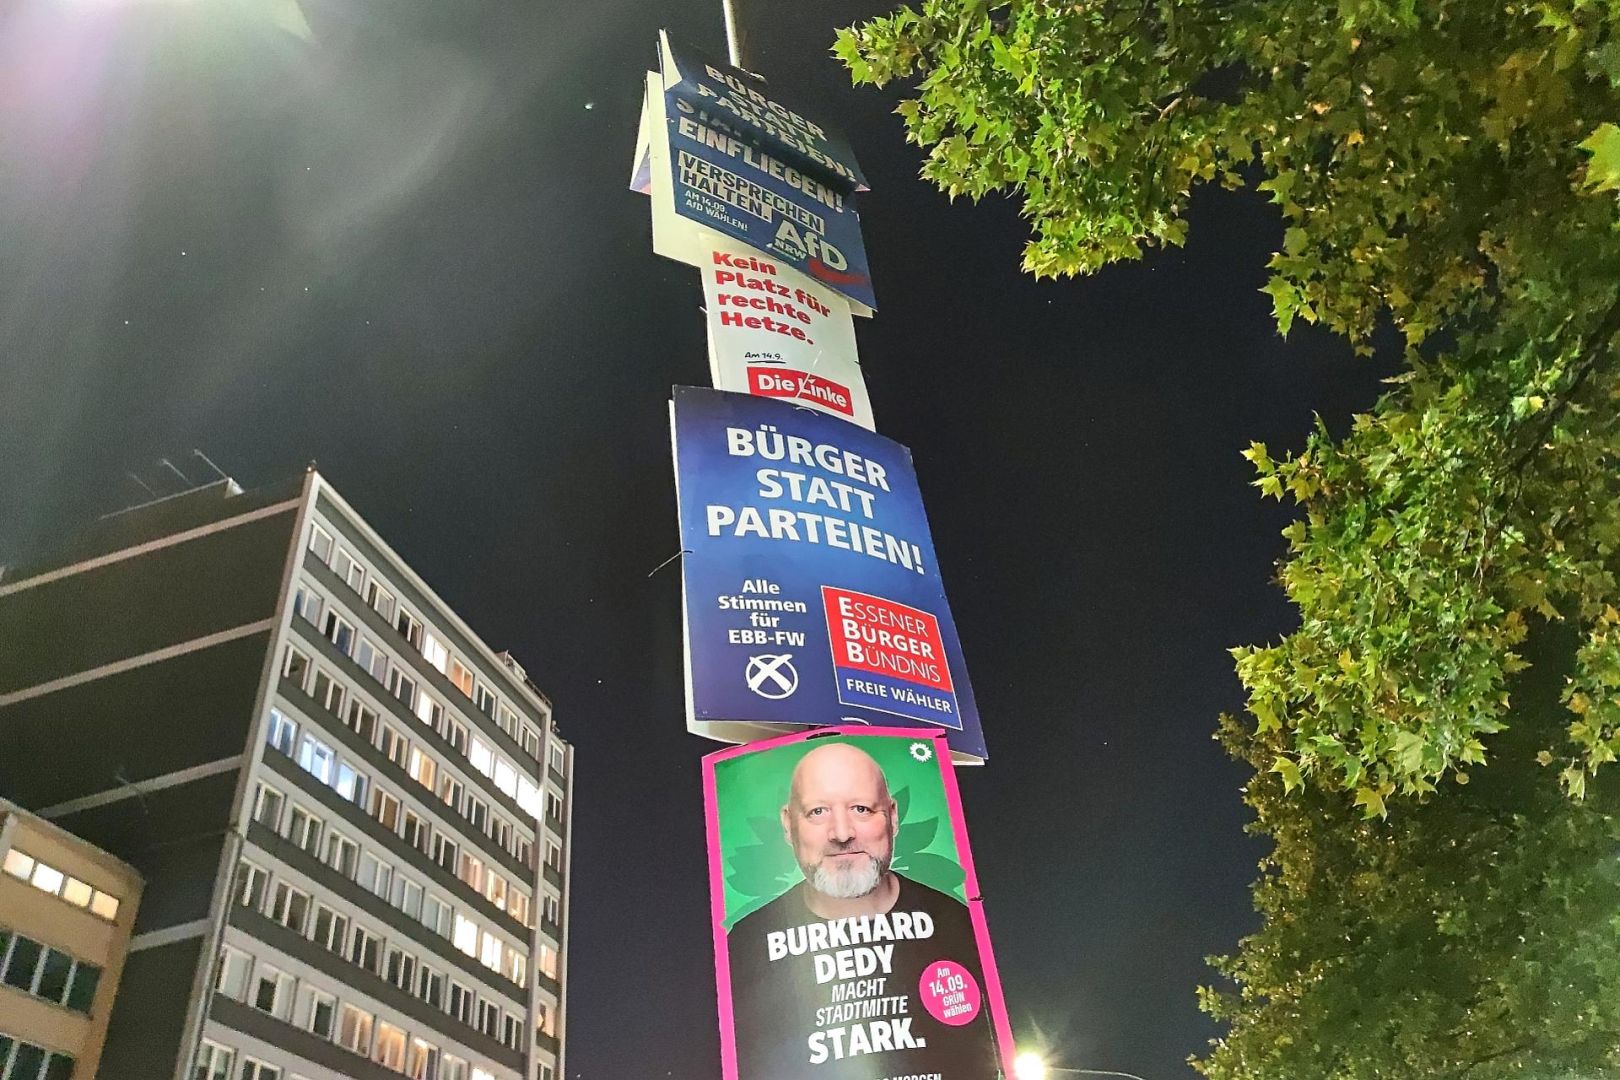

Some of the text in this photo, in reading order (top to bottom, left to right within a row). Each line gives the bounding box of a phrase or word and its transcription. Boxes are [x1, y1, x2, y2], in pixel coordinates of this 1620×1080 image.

[697, 83, 857, 182] PARTEIEN!
[678, 116, 844, 213] EINFLIEGEN!
[681, 152, 823, 234] VERSPRECHEN
[682, 168, 771, 221] HALTEN.
[685, 190, 701, 202] AM
[685, 200, 704, 212] AfD
[774, 238, 806, 261] NRW
[775, 219, 848, 271] AfD
[712, 251, 777, 276] Kein
[715, 269, 831, 318] Platz für
[718, 293, 812, 325] rechte
[720, 311, 814, 345] Hetze.
[744, 351, 784, 361] Am 14.9.
[758, 374, 848, 408] Die Linke
[726, 424, 891, 492] BÜRGER
[756, 468, 875, 520] STATT
[706, 504, 925, 576] PARTEIEN!
[718, 595, 807, 613] Stimmen
[742, 579, 780, 595] Alle
[749, 611, 780, 628] für
[838, 596, 929, 638] ESSENER
[728, 629, 805, 647] EBB-FW
[842, 618, 936, 660] BÜRGER
[847, 641, 941, 683] BÜNDNIS
[846, 677, 953, 714] FREIE WÄHLER
[766, 911, 935, 962] BURKHARD
[813, 944, 895, 985] DEDY
[937, 967, 951, 978] Am
[832, 978, 887, 1003] MACHT
[929, 974, 968, 998] 14.09.
[942, 992, 965, 1007] GRÜN
[816, 995, 908, 1027] STADTMITTE
[943, 1002, 972, 1018] wählen
[808, 1017, 926, 1065] STARK.
